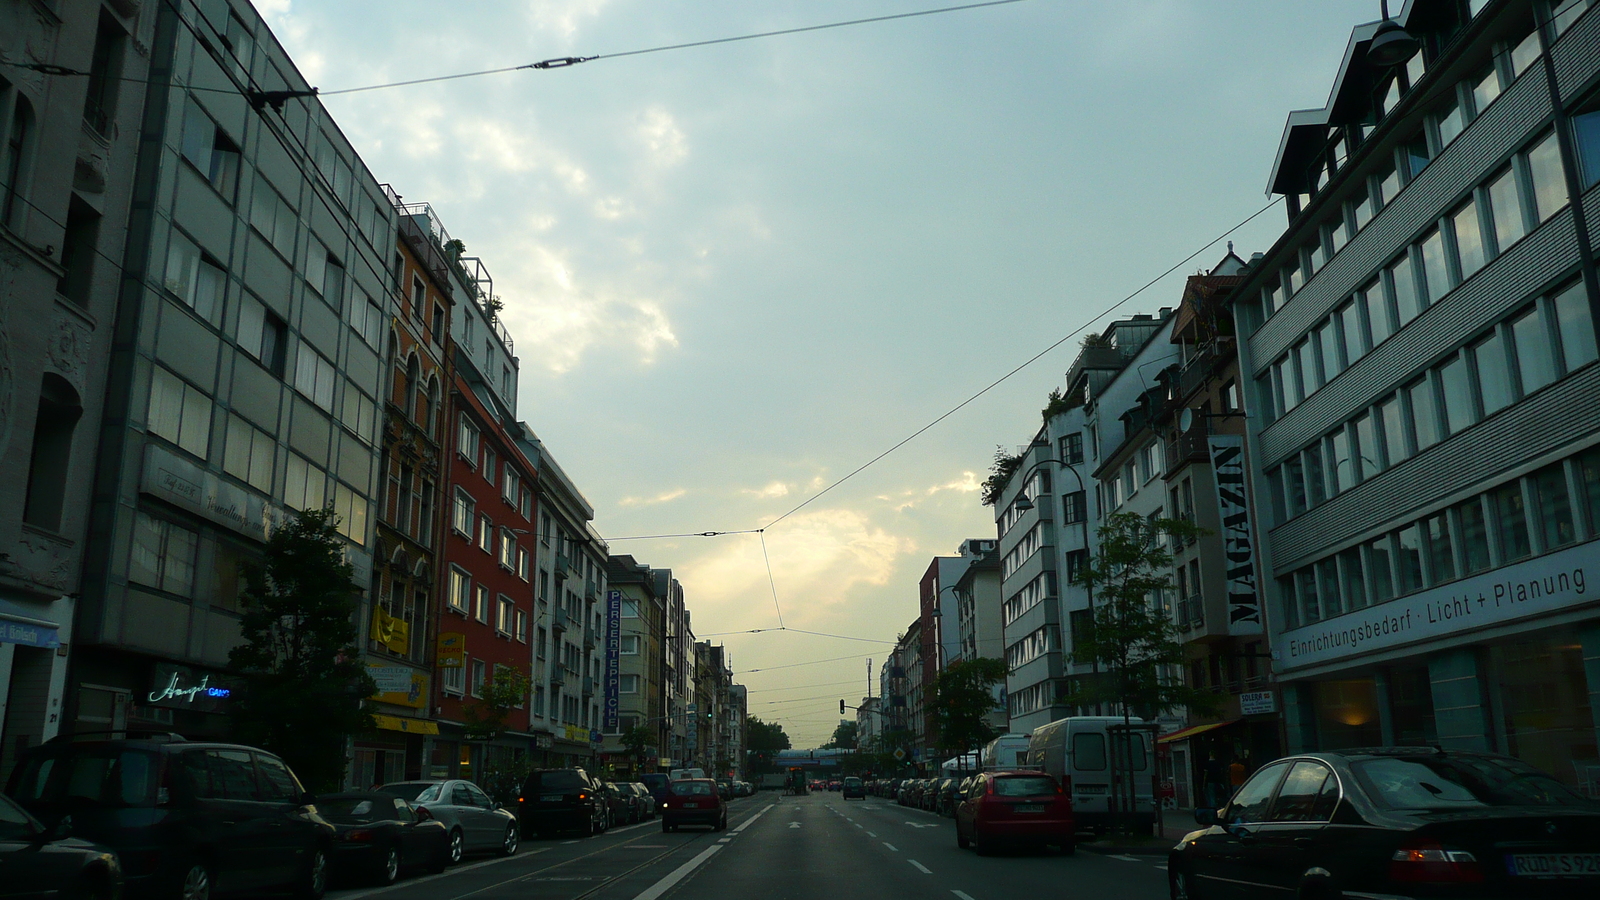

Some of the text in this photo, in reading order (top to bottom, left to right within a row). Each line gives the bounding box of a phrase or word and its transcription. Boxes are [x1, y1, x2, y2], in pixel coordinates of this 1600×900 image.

[1211, 443, 1261, 626] MAGAZIN
[1290, 608, 1413, 658] Einrichtungsbedarf
[1427, 594, 1472, 626] Licht
[1493, 567, 1587, 608] Planung
[438, 647, 462, 655] GECKO
[607, 591, 620, 728] PERSERTEPPICHE
[1241, 692, 1263, 703] SOLERA
[49, 713, 57, 723] 21
[1515, 854, 1549, 873] RÜD
[1560, 855, 1573, 873] S
